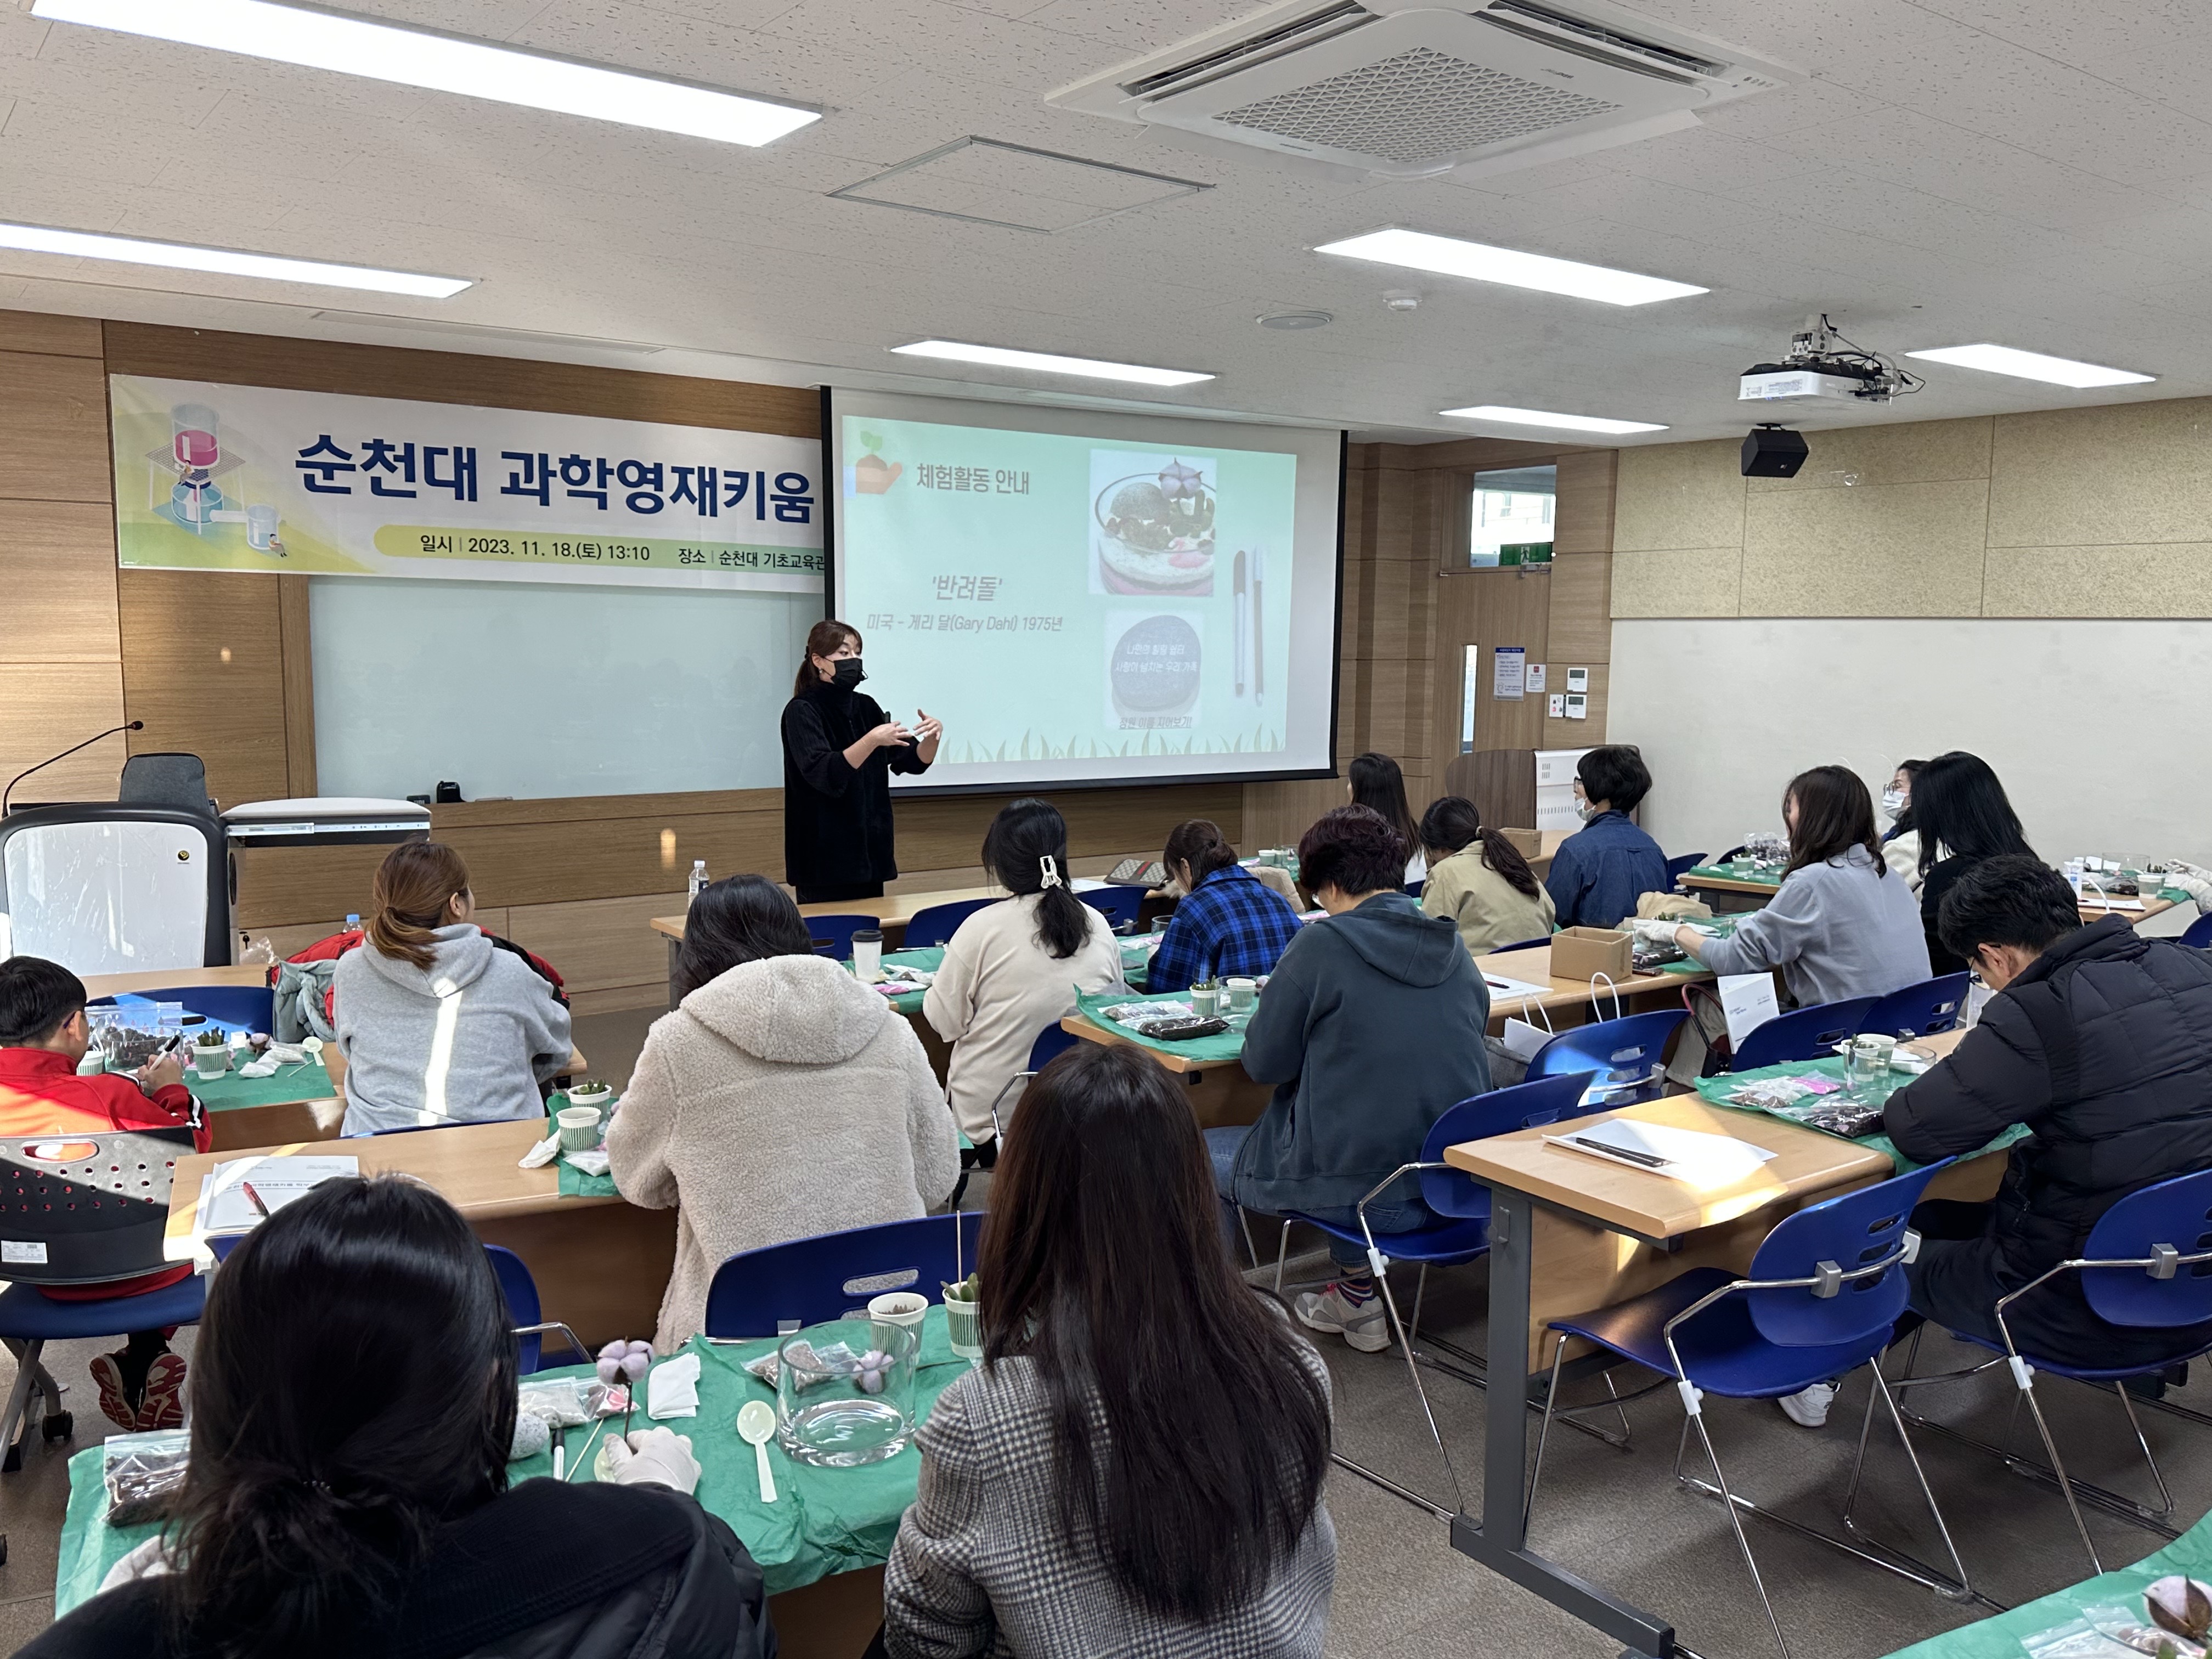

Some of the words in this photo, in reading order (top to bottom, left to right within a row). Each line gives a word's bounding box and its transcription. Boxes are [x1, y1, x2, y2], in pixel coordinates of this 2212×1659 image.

[295, 434, 477, 502] 순천대
[500, 450, 815, 524] 과학영재키움
[917, 462, 990, 493] 체험활동
[995, 469, 1030, 495] 안내
[420, 535, 452, 553] 일시
[468, 538, 514, 555] 2023.
[521, 540, 545, 556] 11.
[607, 545, 650, 561] 13:10
[678, 548, 706, 564] 장소
[719, 550, 758, 568] 순천대
[866, 613, 894, 630] 미국
[907, 614, 934, 630] 게리
[987, 615, 1018, 631] Dahl)
[1022, 616, 1063, 631] 1975년
[1126, 643, 1150, 656] 나만의
[1114, 661, 1139, 673] 사랑이
[1139, 661, 1164, 673] 넘치는
[1165, 661, 1181, 672] 우리
[1181, 661, 1198, 673] 가족
